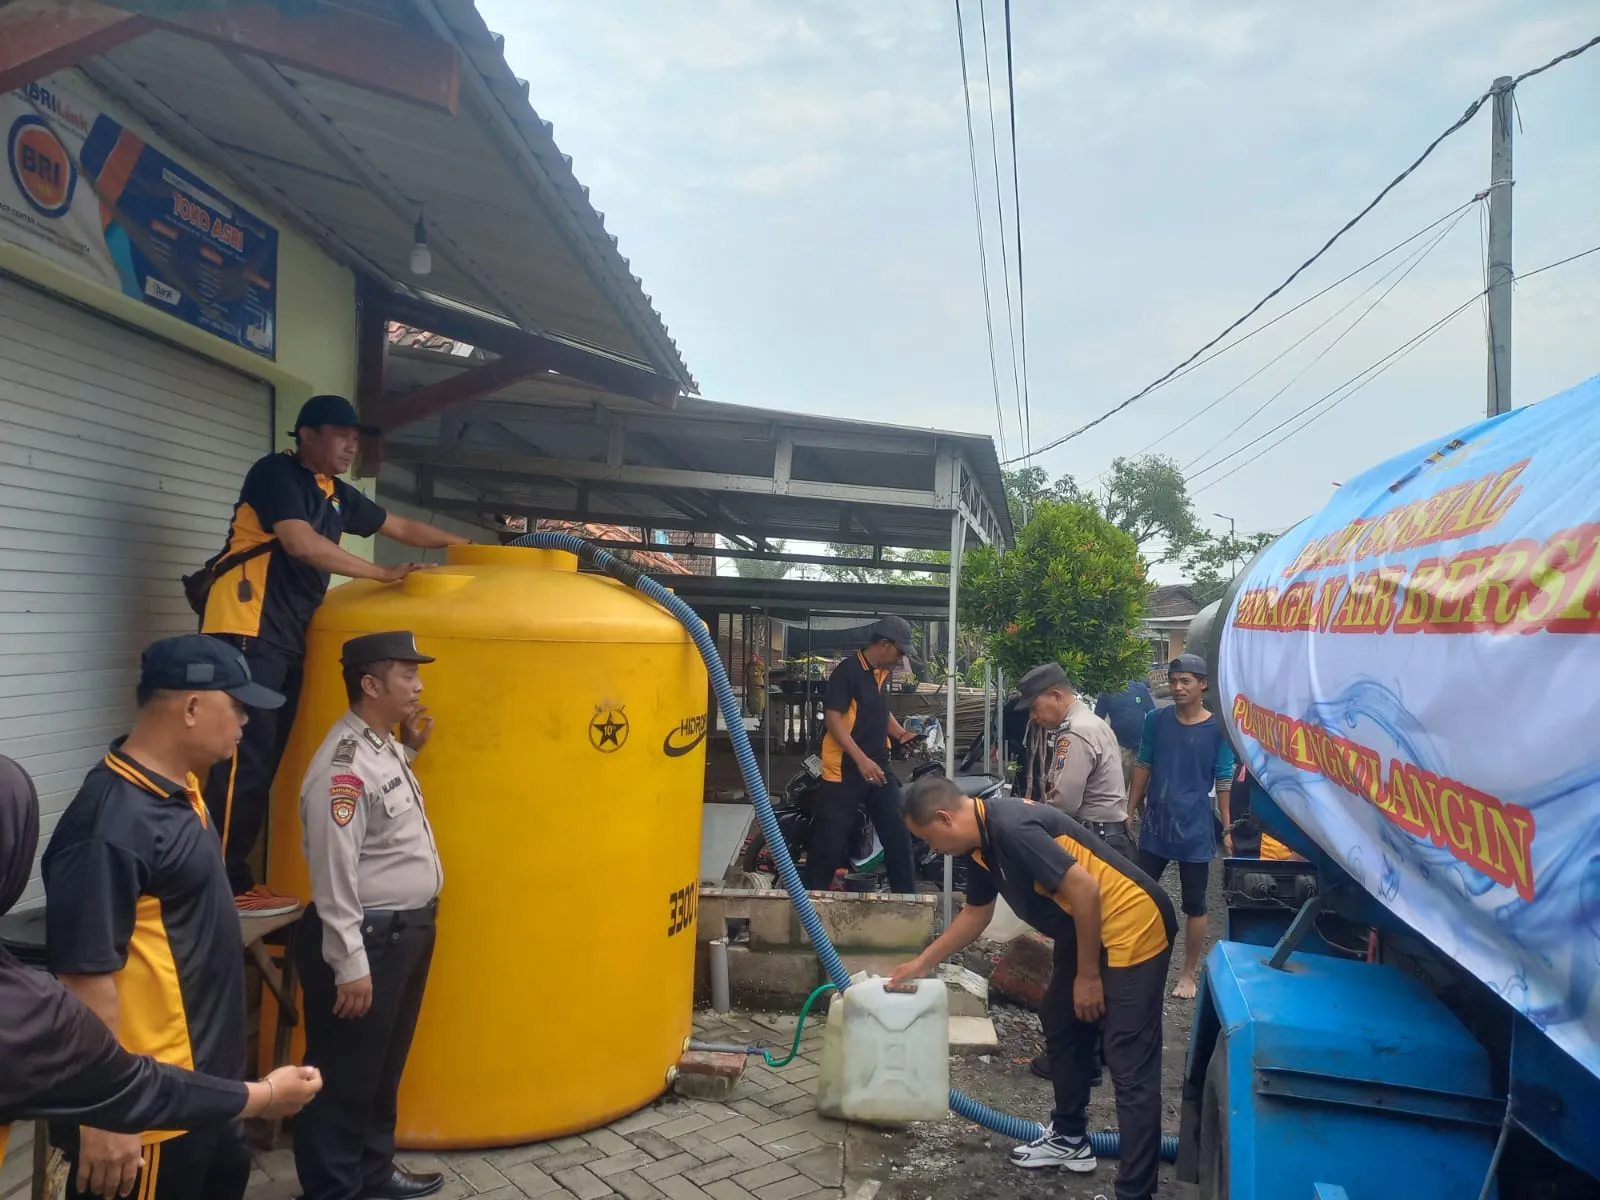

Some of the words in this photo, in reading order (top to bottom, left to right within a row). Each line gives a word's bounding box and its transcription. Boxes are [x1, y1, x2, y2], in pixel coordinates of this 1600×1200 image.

[22, 144, 60, 189] BRI
[173, 191, 210, 232] TOKO
[1331, 567, 1405, 632] AIR
[1395, 525, 1600, 632] BERSI
